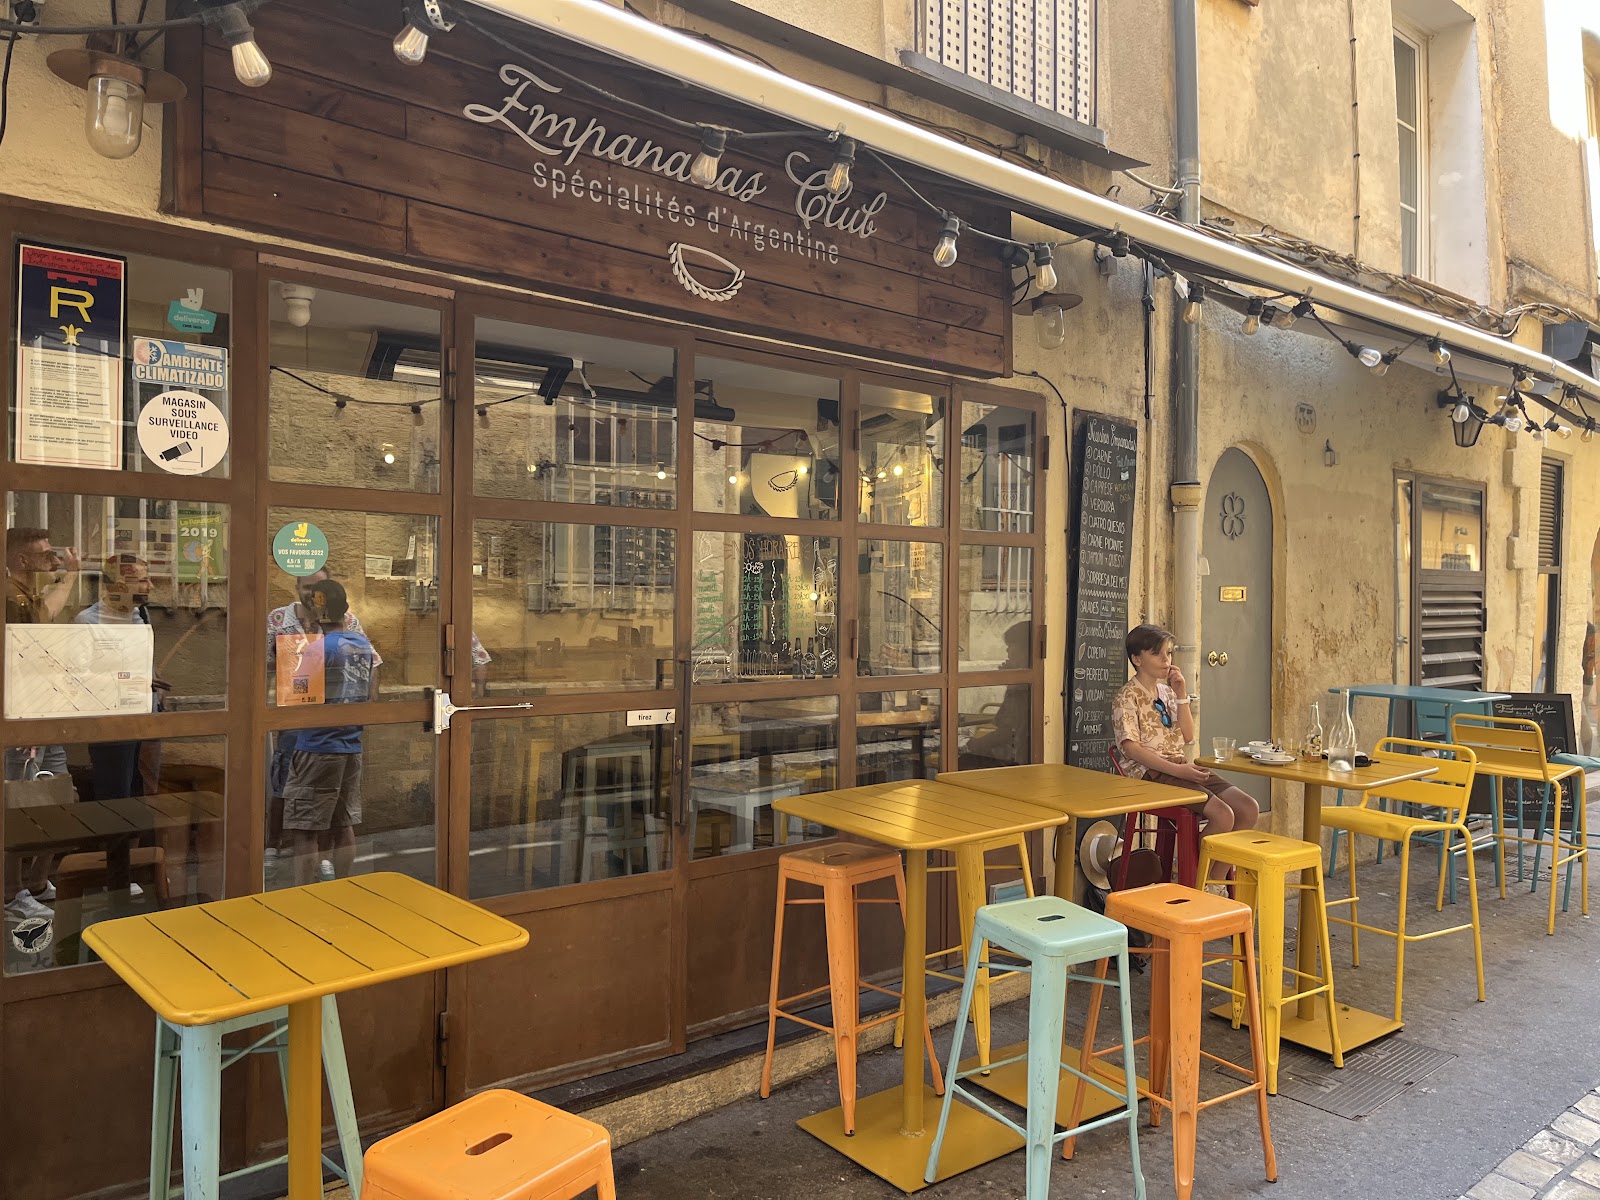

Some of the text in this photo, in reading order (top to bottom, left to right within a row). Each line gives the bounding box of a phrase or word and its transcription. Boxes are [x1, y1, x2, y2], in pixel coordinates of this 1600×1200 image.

[463, 63, 888, 239] Empanaas Club
[707, 206, 839, 265] d'Argentine
[51, 286, 94, 323] R
[173, 314, 210, 325] deliveroo
[162, 353, 223, 373] AMBIENTE
[135, 365, 224, 388] CLIMATIZADO
[162, 397, 206, 409] MAGASIN
[171, 409, 197, 419] SOUS
[148, 416, 219, 432] SURVEILLANCE
[170, 429, 198, 440] VIDEO
[1093, 447, 1112, 464] CARNE
[1090, 479, 1113, 496] CAPRESE
[180, 527, 218, 538] 2019
[1088, 514, 1107, 530] CUATRO
[1107, 519, 1125, 535] QUESOS
[1087, 533, 1103, 549] CARNE
